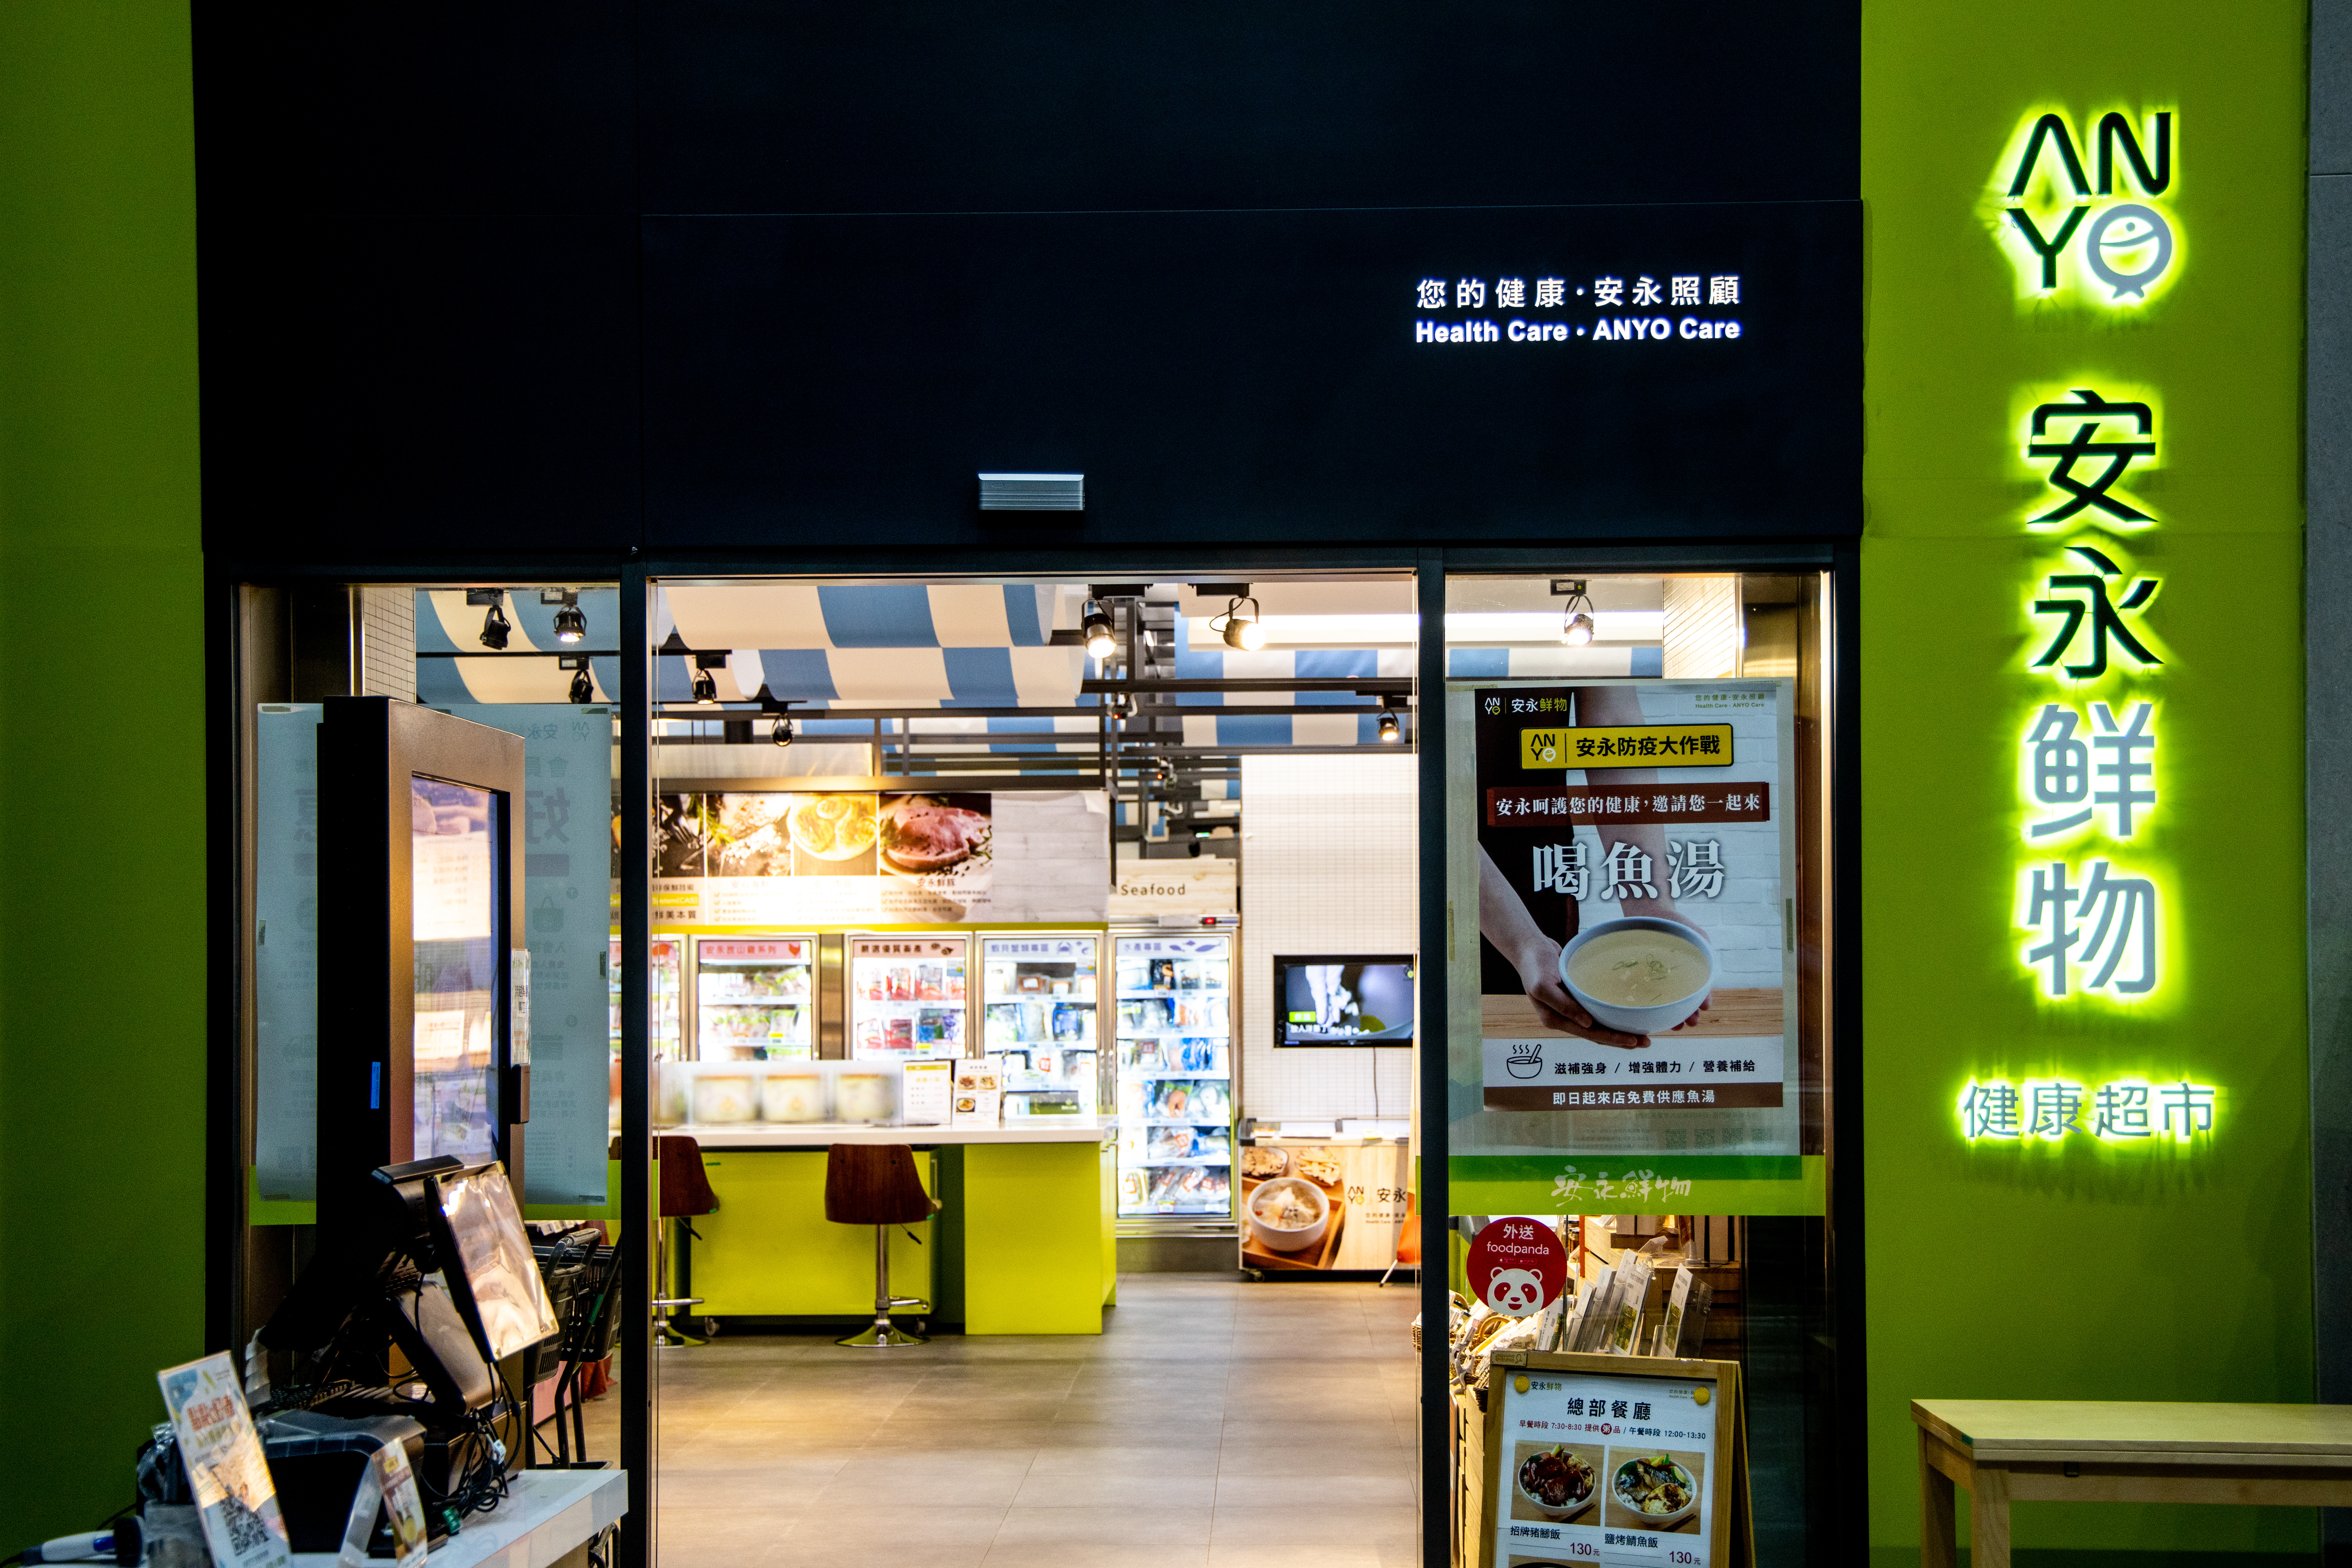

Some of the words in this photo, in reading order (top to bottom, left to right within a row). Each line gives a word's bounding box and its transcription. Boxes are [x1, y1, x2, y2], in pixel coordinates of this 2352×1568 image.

[1415, 321, 1498, 343] Health
[1507, 320, 1567, 342] Care
[1593, 318, 1672, 341] ANYO
[1679, 318, 1740, 340] Care
[1576, 735, 1720, 757] 安永防疫大作戰
[1533, 839, 1725, 901] 喝魚湯
[1121, 883, 1186, 895] Seafood
[1554, 1061, 1607, 1075] 滋補強身
[1628, 1061, 1681, 1074] 增強體力
[1703, 1060, 1755, 1073] 營養補給
[1553, 1089, 1715, 1105] 即日起來店免費供應魚湯
[1963, 1082, 2215, 1138] 健康超市
[1377, 1188, 1406, 1202] 安永
[1503, 1223, 1534, 1240] 外送
[1487, 1241, 1550, 1256] foodpanda
[1567, 1397, 1651, 1421] 總部餐廳
[1519, 1420, 1548, 1429] 早餐時段
[1551, 1422, 1582, 1431] 7:30~8:30
[1629, 1427, 1661, 1437] 午餐時段
[1664, 1430, 1706, 1439] 12:00~13:30
[1510, 1525, 1561, 1540] 招牌豬腳飯
[1605, 1533, 1658, 1548] 鹽烤鯖魚飯
